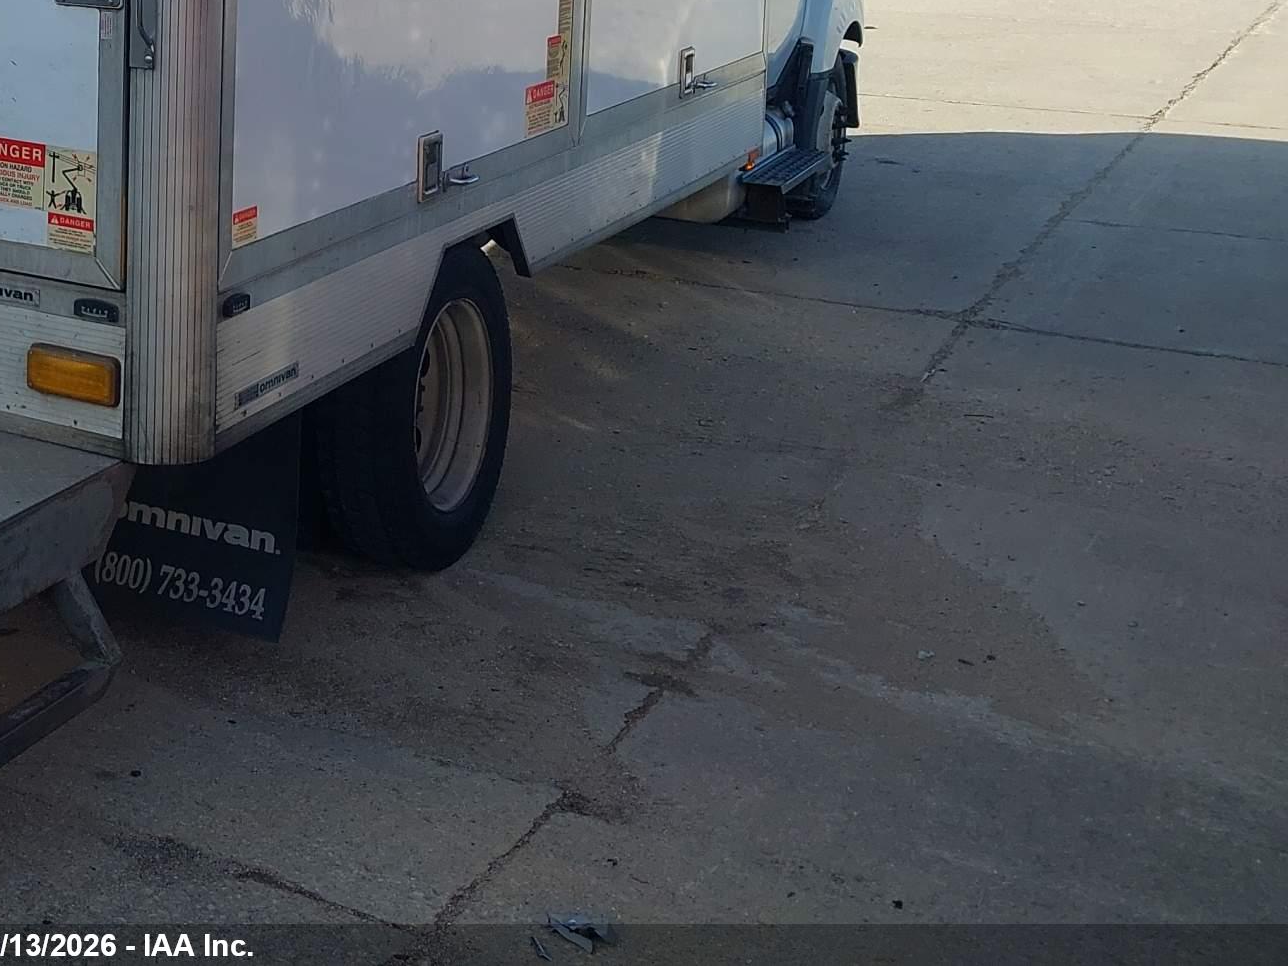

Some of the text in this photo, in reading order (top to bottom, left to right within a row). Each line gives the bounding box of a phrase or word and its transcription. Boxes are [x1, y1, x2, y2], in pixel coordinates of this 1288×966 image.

[9, 162, 31, 171] HAZARD
[17, 171, 39, 180] INJURY
[59, 217, 91, 229] DANGER
[260, 367, 297, 393] omnivan
[94, 551, 266, 621] (800) 733-3434
